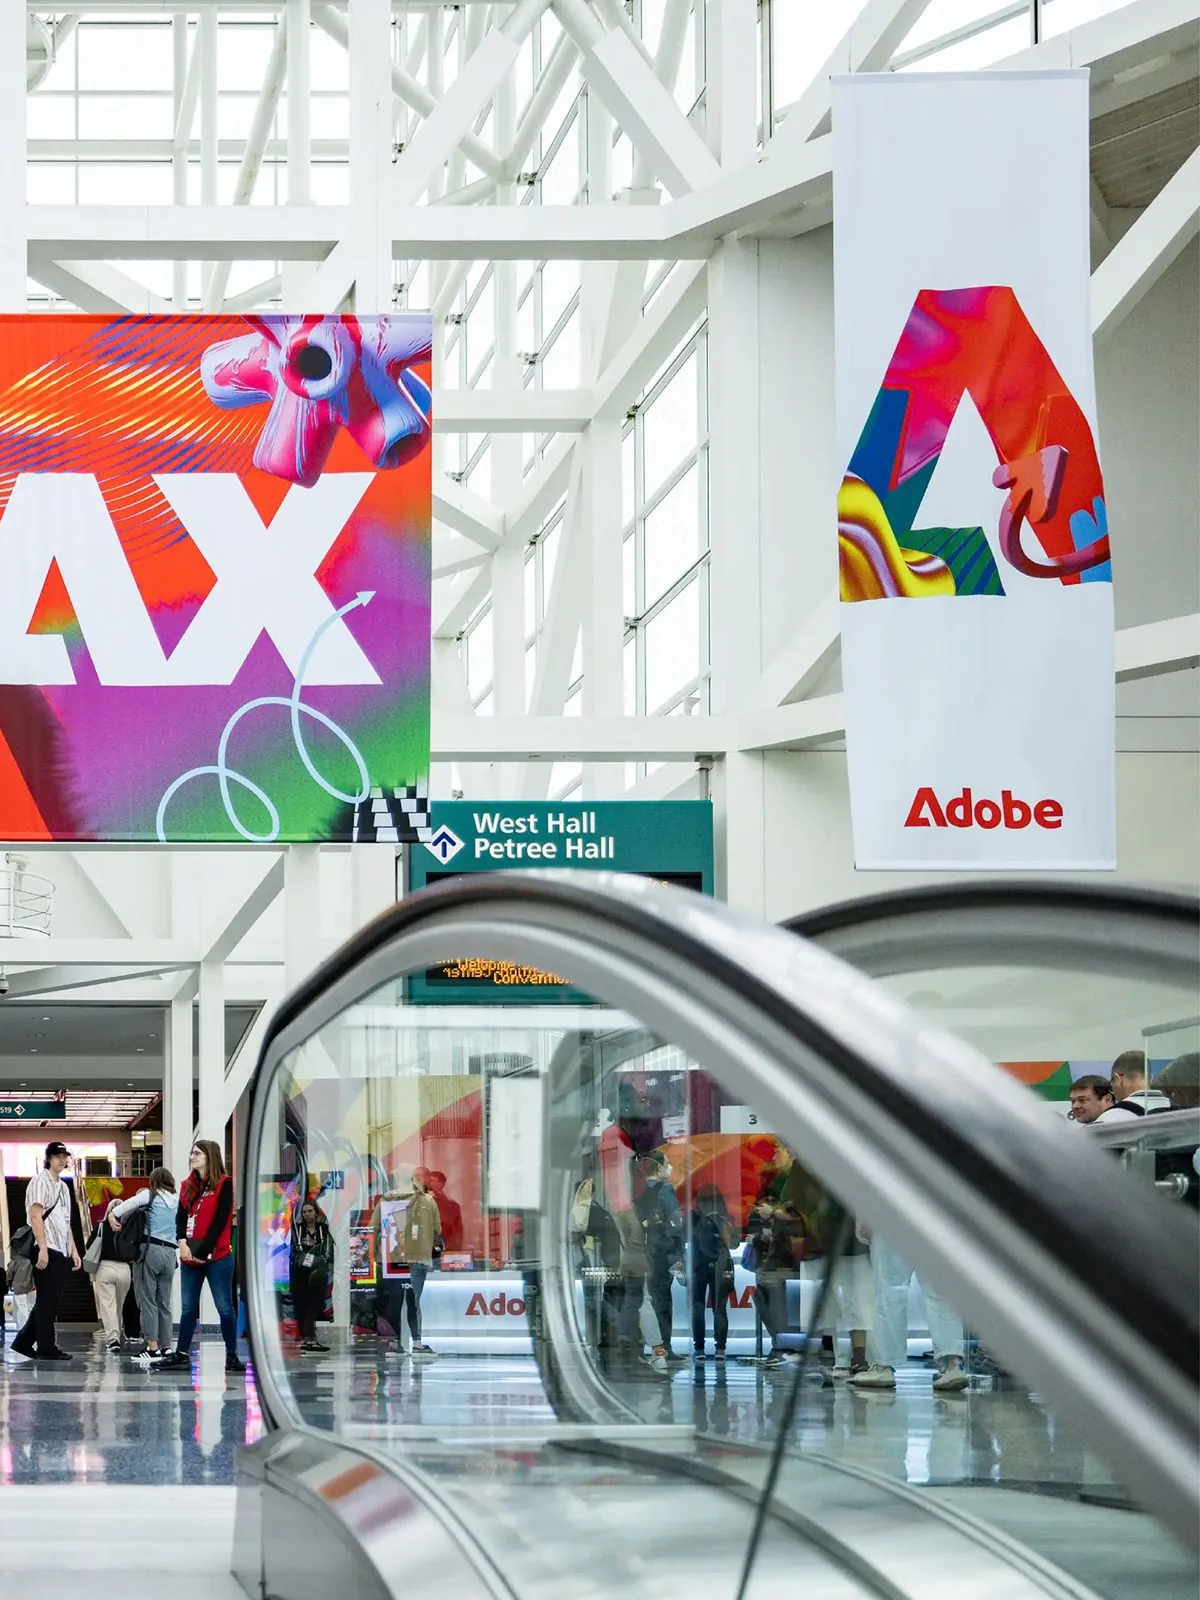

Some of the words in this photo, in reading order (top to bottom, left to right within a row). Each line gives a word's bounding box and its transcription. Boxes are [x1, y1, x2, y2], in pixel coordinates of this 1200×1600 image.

[904, 787, 1064, 830] Adobe
[473, 812, 538, 834] West
[548, 811, 596, 834] Hall
[474, 837, 557, 859] Petree
[566, 836, 615, 859] Hall
[748, 1113, 758, 1125] 3
[465, 1293, 527, 1316] Ado
